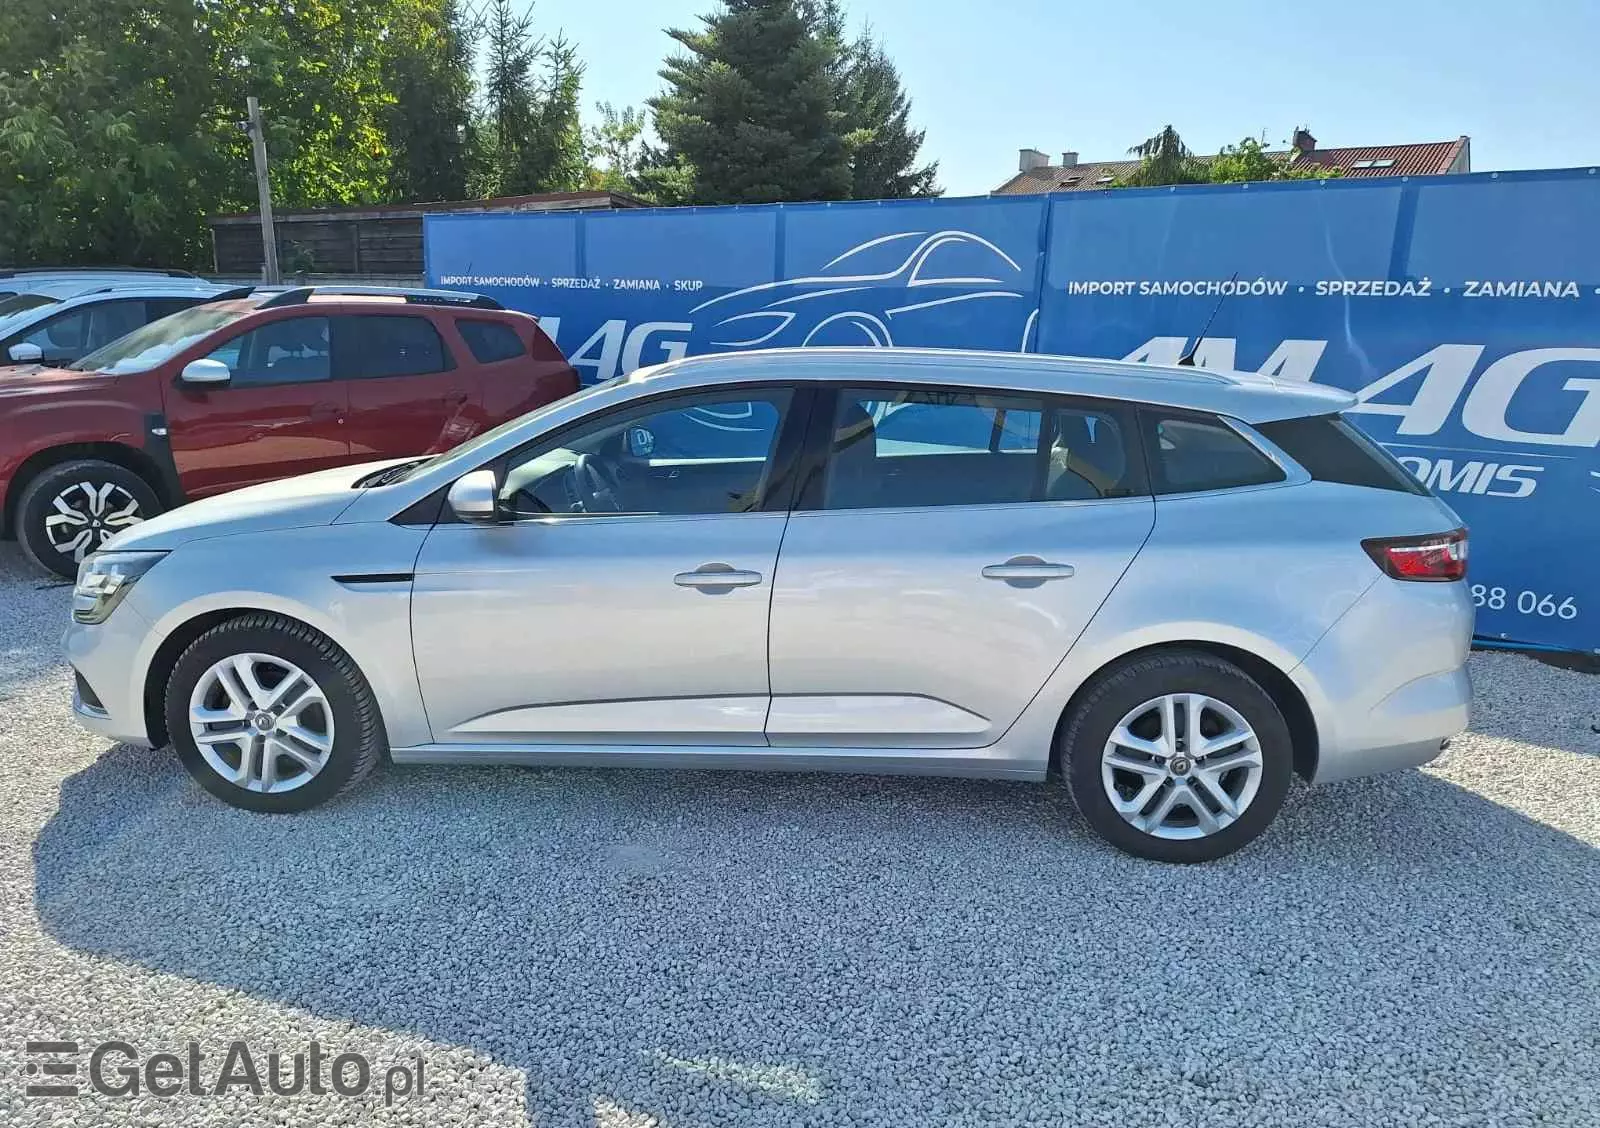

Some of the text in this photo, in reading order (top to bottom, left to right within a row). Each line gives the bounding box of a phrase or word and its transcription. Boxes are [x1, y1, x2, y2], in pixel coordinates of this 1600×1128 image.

[440, 275, 703, 292] IMPORT SAMOCHODÓW SPRZEDAŻ ZAMIANA SKUP
[1068, 276, 1581, 298] IMPORT SAMOCHODÓW SPRZEDAŻ ZAMIANA
[1517, 590, 1578, 620] 066
